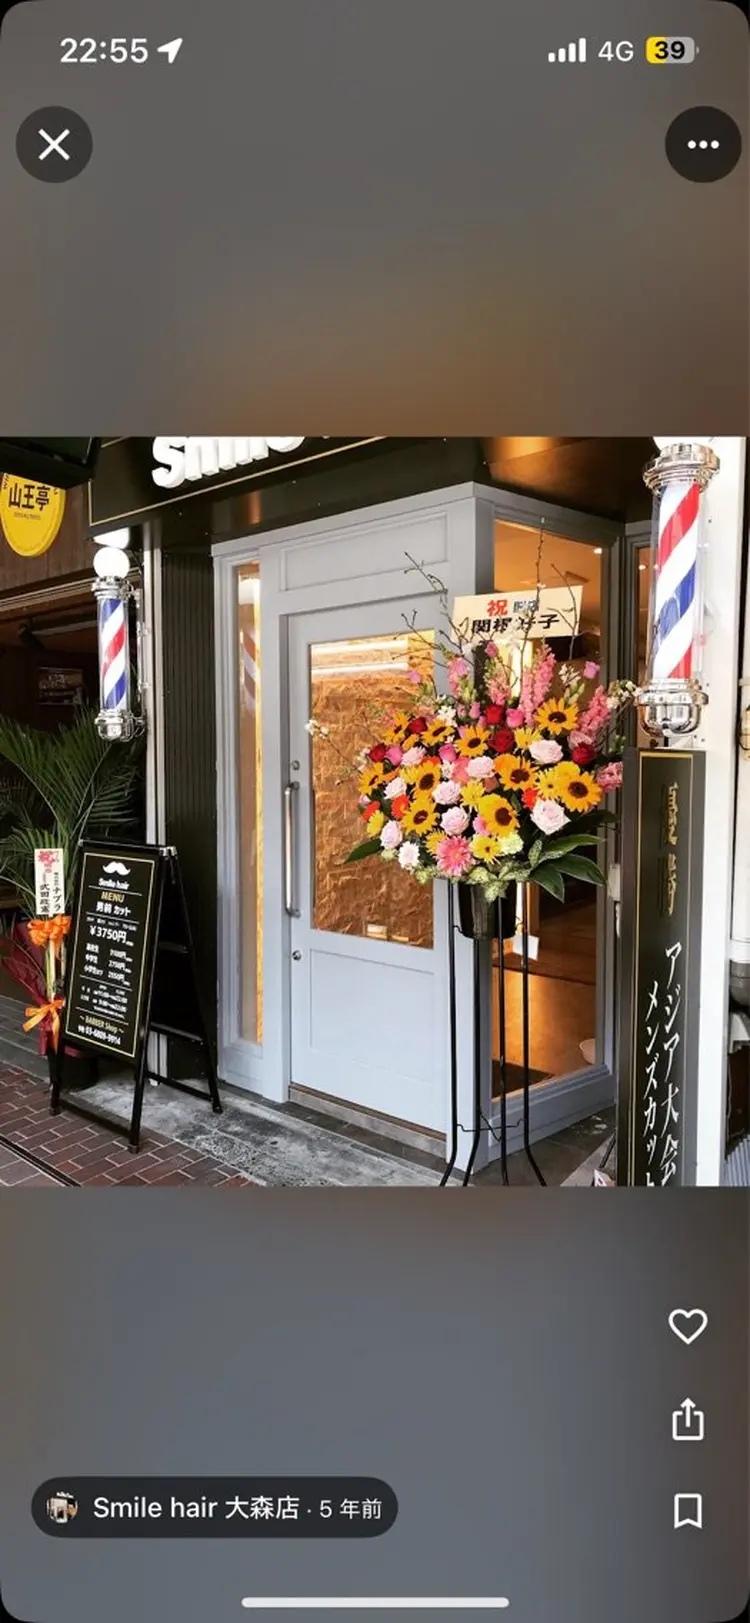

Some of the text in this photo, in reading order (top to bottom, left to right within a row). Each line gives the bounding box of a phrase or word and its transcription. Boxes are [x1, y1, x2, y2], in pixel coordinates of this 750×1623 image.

[9, 483, 50, 511] 山王亭
[487, 599, 508, 617] 祝
[101, 891, 125, 903] MENU
[661, 942, 682, 1186] アジア大会
